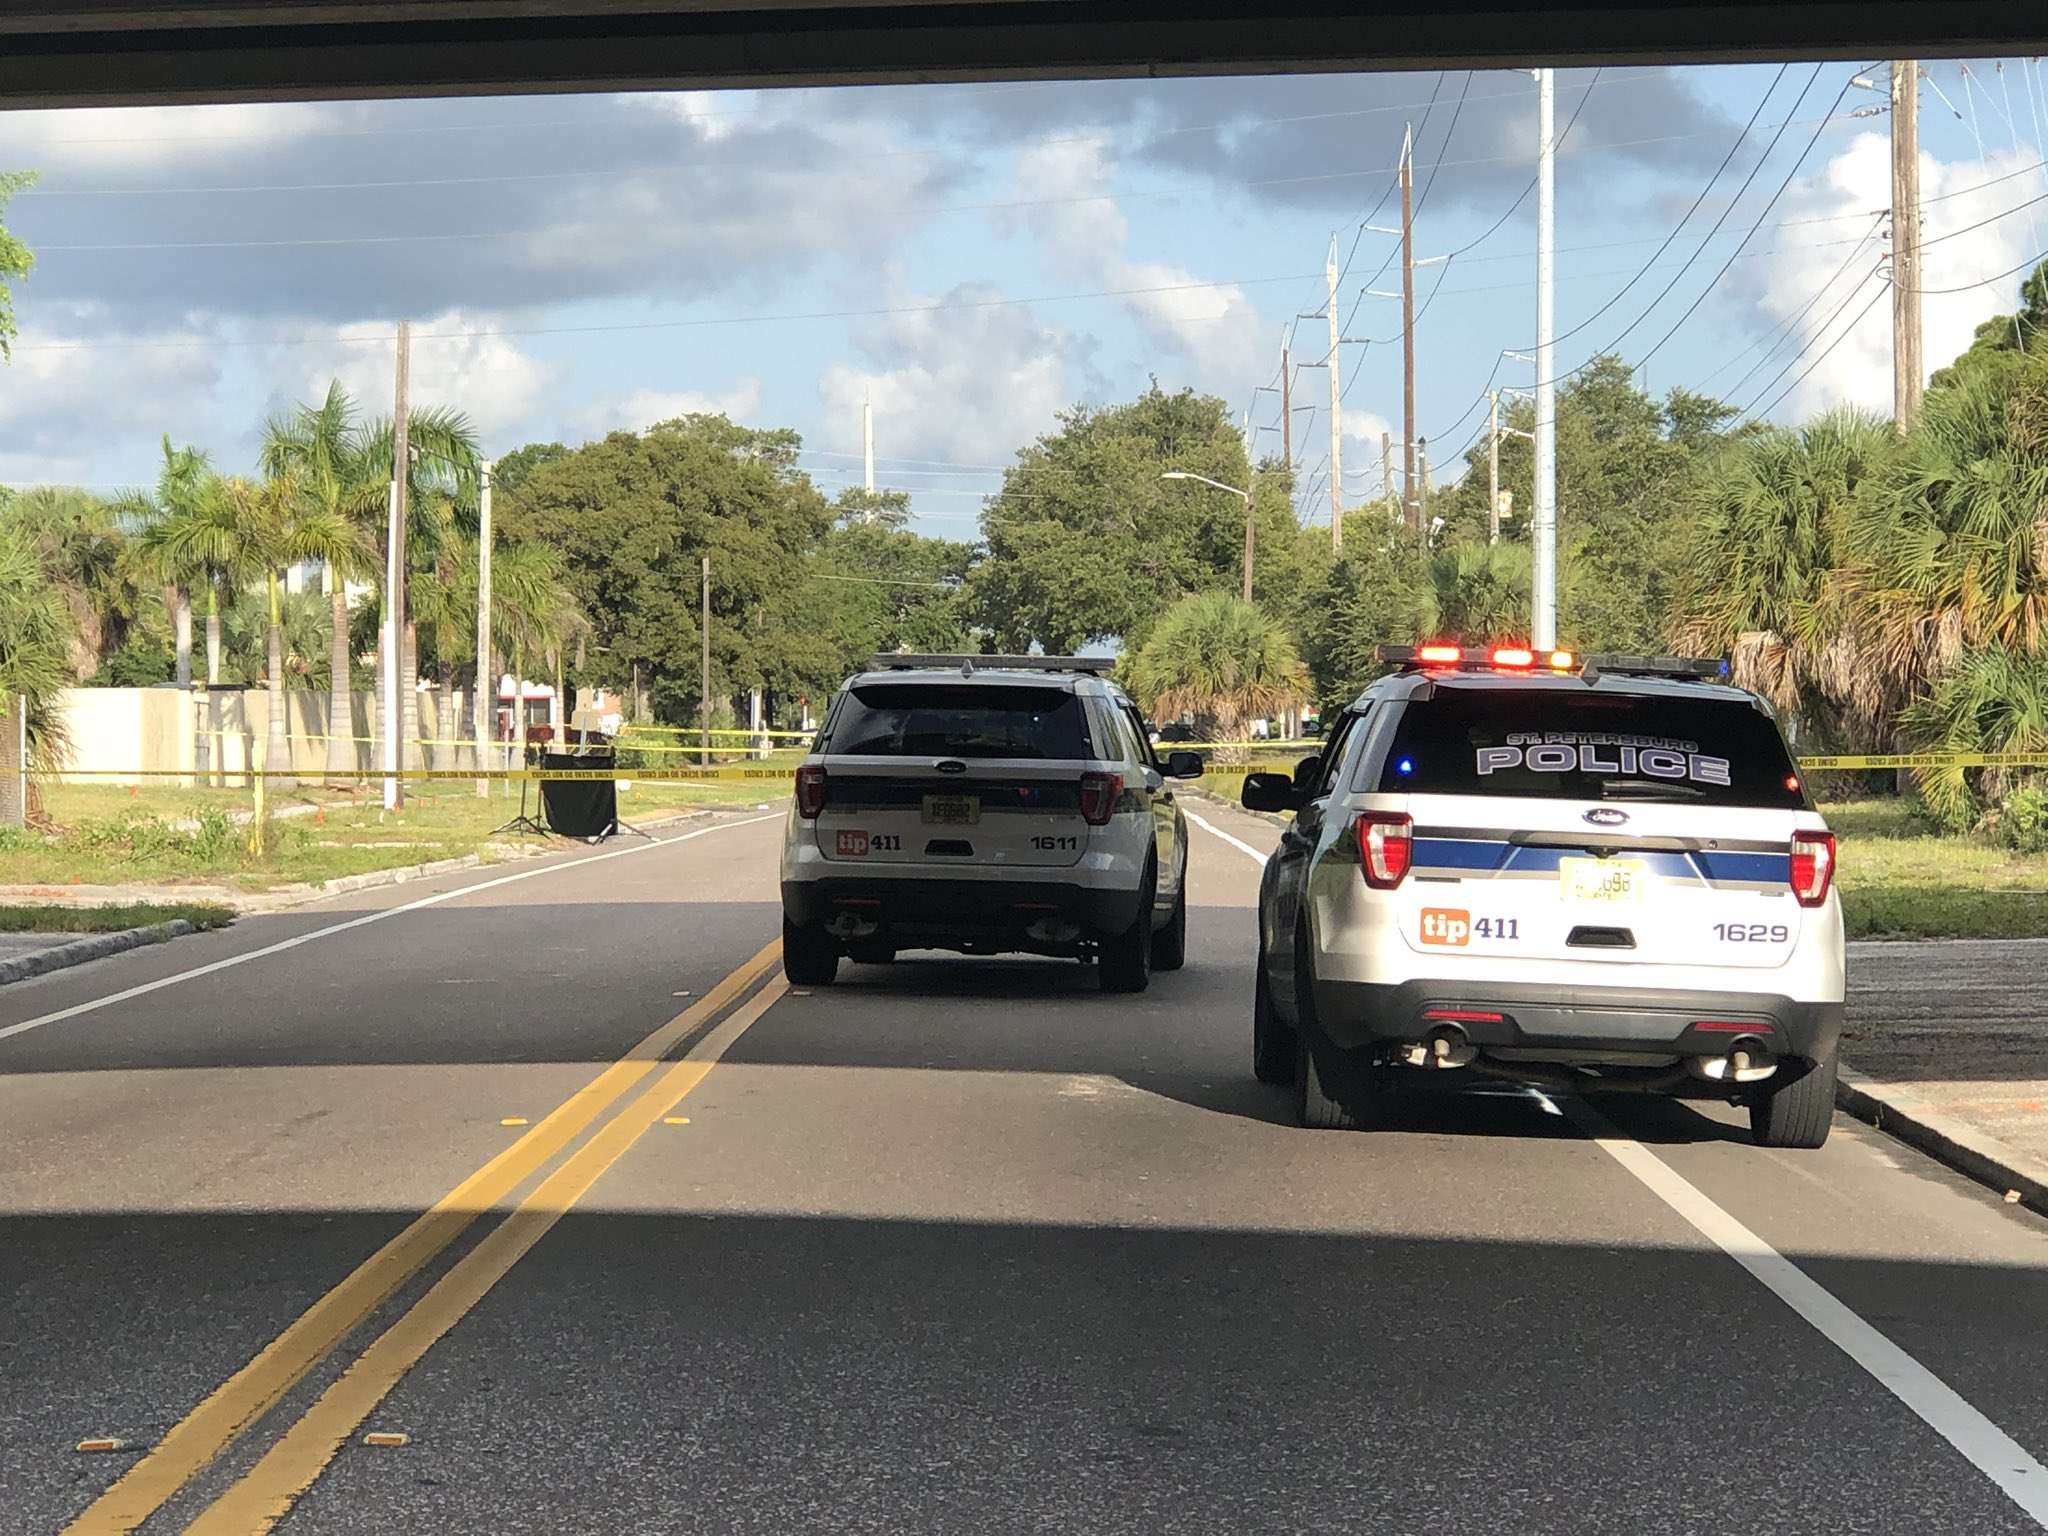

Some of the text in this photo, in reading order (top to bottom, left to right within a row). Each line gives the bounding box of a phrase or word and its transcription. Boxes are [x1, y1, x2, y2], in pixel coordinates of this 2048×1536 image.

[1506, 731, 1699, 752] ST. PETERSBURG
[1476, 744, 1732, 786] POLICE
[839, 833, 901, 854] tip 411
[1030, 836, 1078, 850] 1611
[1423, 913, 1519, 943] tip 411
[1712, 923, 1788, 943] 1629
